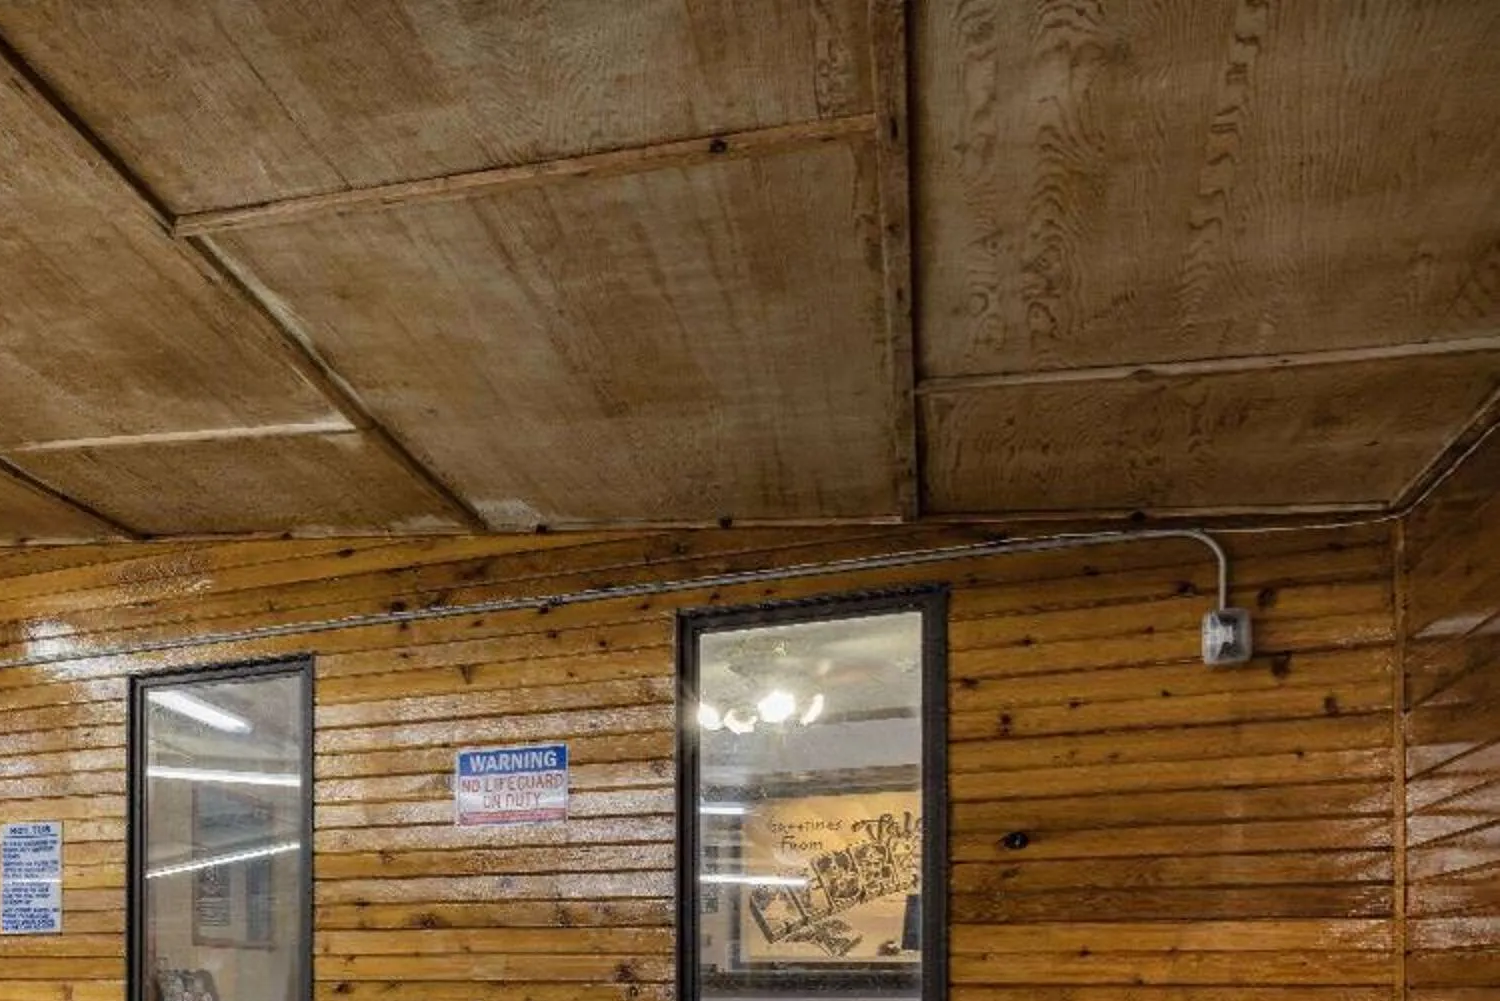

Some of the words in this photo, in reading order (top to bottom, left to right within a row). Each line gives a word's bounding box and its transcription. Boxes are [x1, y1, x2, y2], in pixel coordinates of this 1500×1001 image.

[469, 751, 557, 773] WARNING
[461, 778, 481, 793] NO
[484, 773, 564, 793] LIFEGUARD
[483, 793, 501, 809] ON
[505, 791, 541, 809] DUTY
